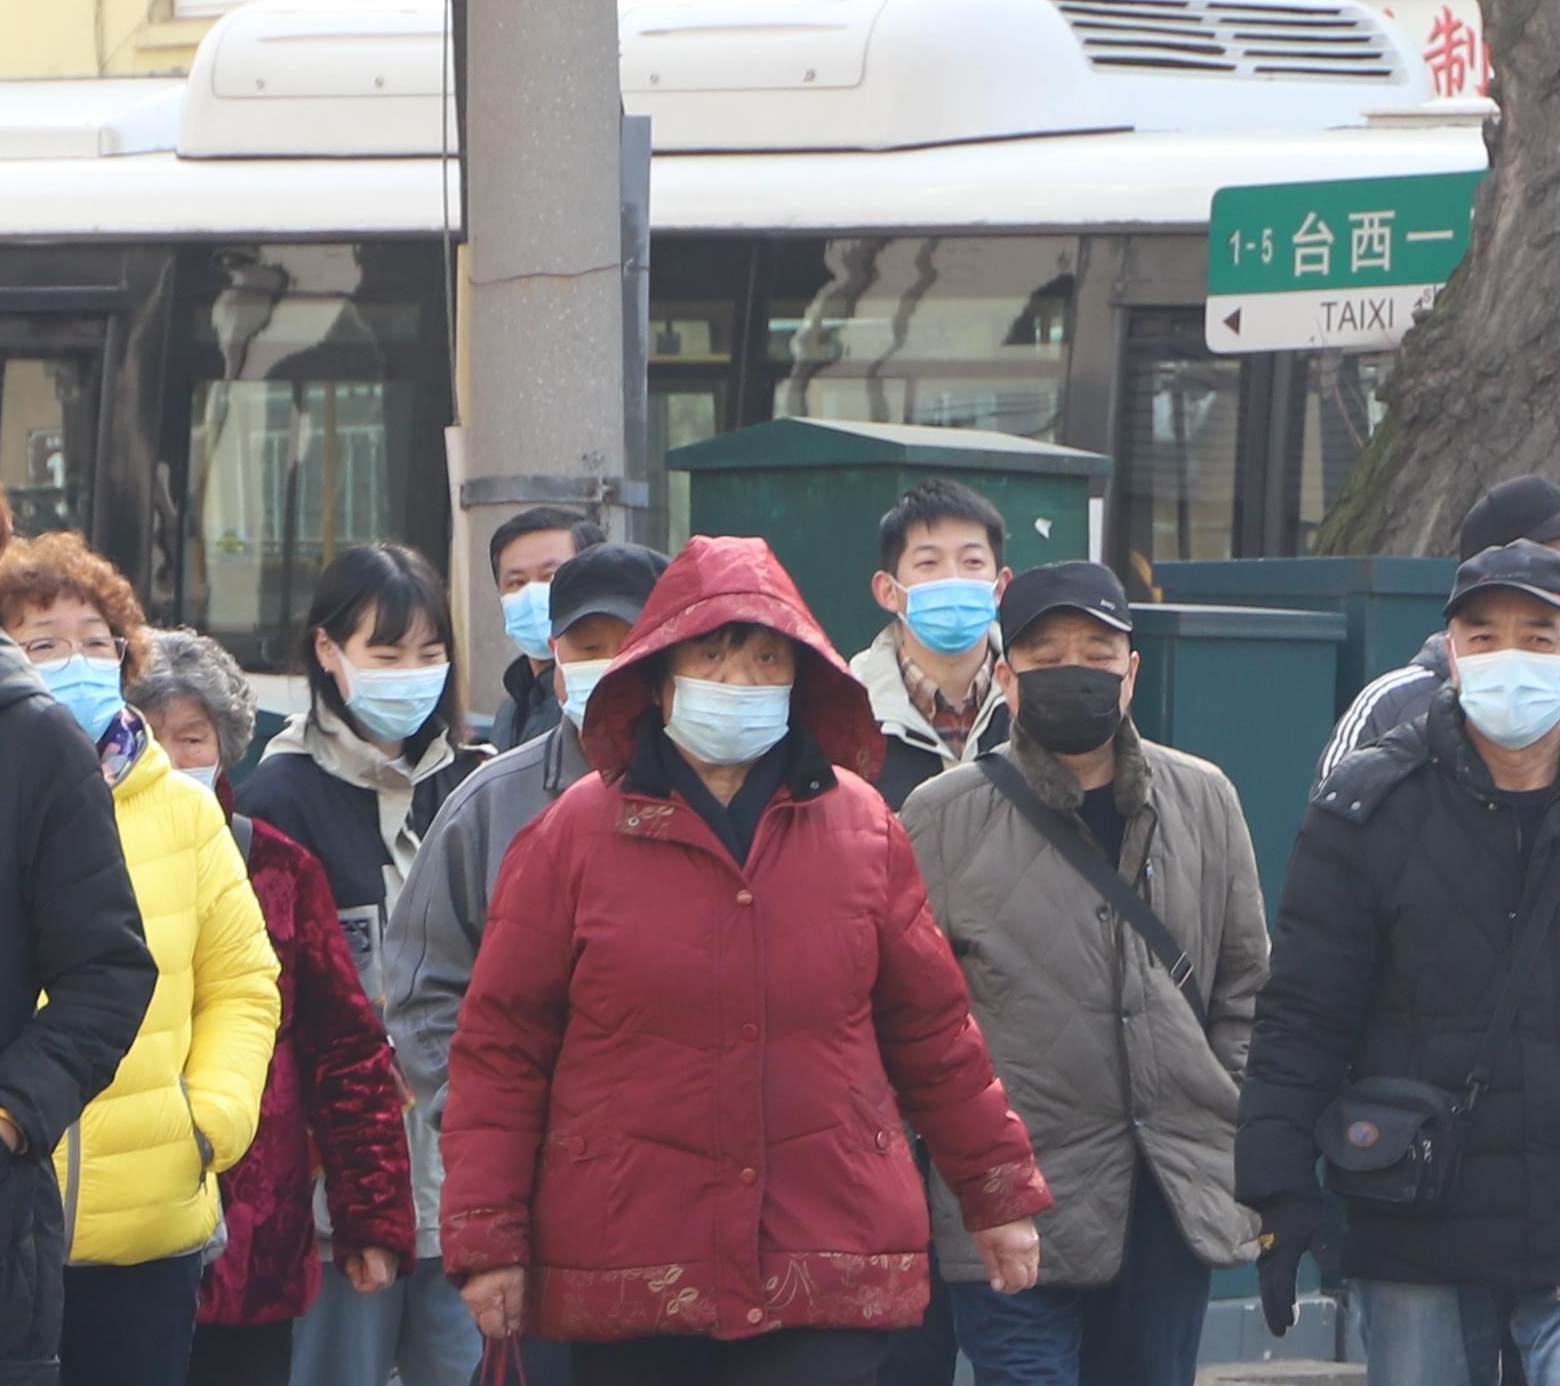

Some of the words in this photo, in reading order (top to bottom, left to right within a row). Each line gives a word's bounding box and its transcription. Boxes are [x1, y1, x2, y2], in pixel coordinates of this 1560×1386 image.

[1229, 227, 1273, 267] 1-5
[1292, 209, 1476, 277] 台西一
[1321, 297, 1395, 332] TAIXI
